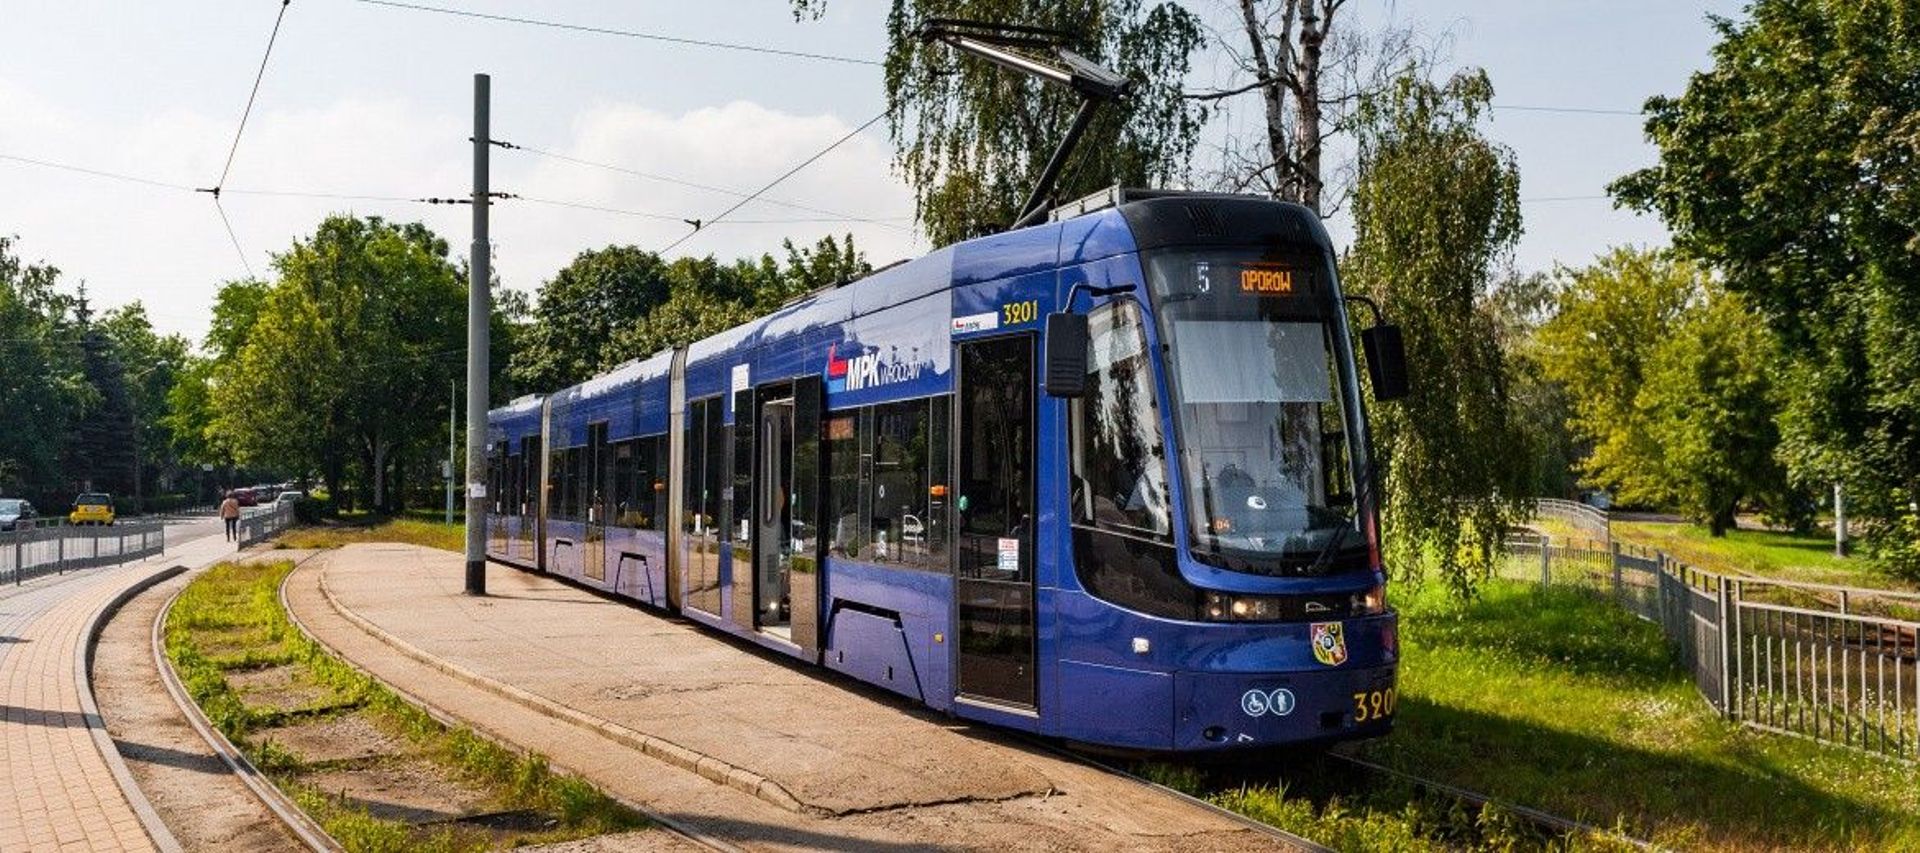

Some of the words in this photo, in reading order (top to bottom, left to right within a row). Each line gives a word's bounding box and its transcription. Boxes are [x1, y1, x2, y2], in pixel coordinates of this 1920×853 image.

[1197, 261, 1210, 293] 5
[1003, 300, 1038, 325] 3201
[846, 353, 881, 391] MPK
